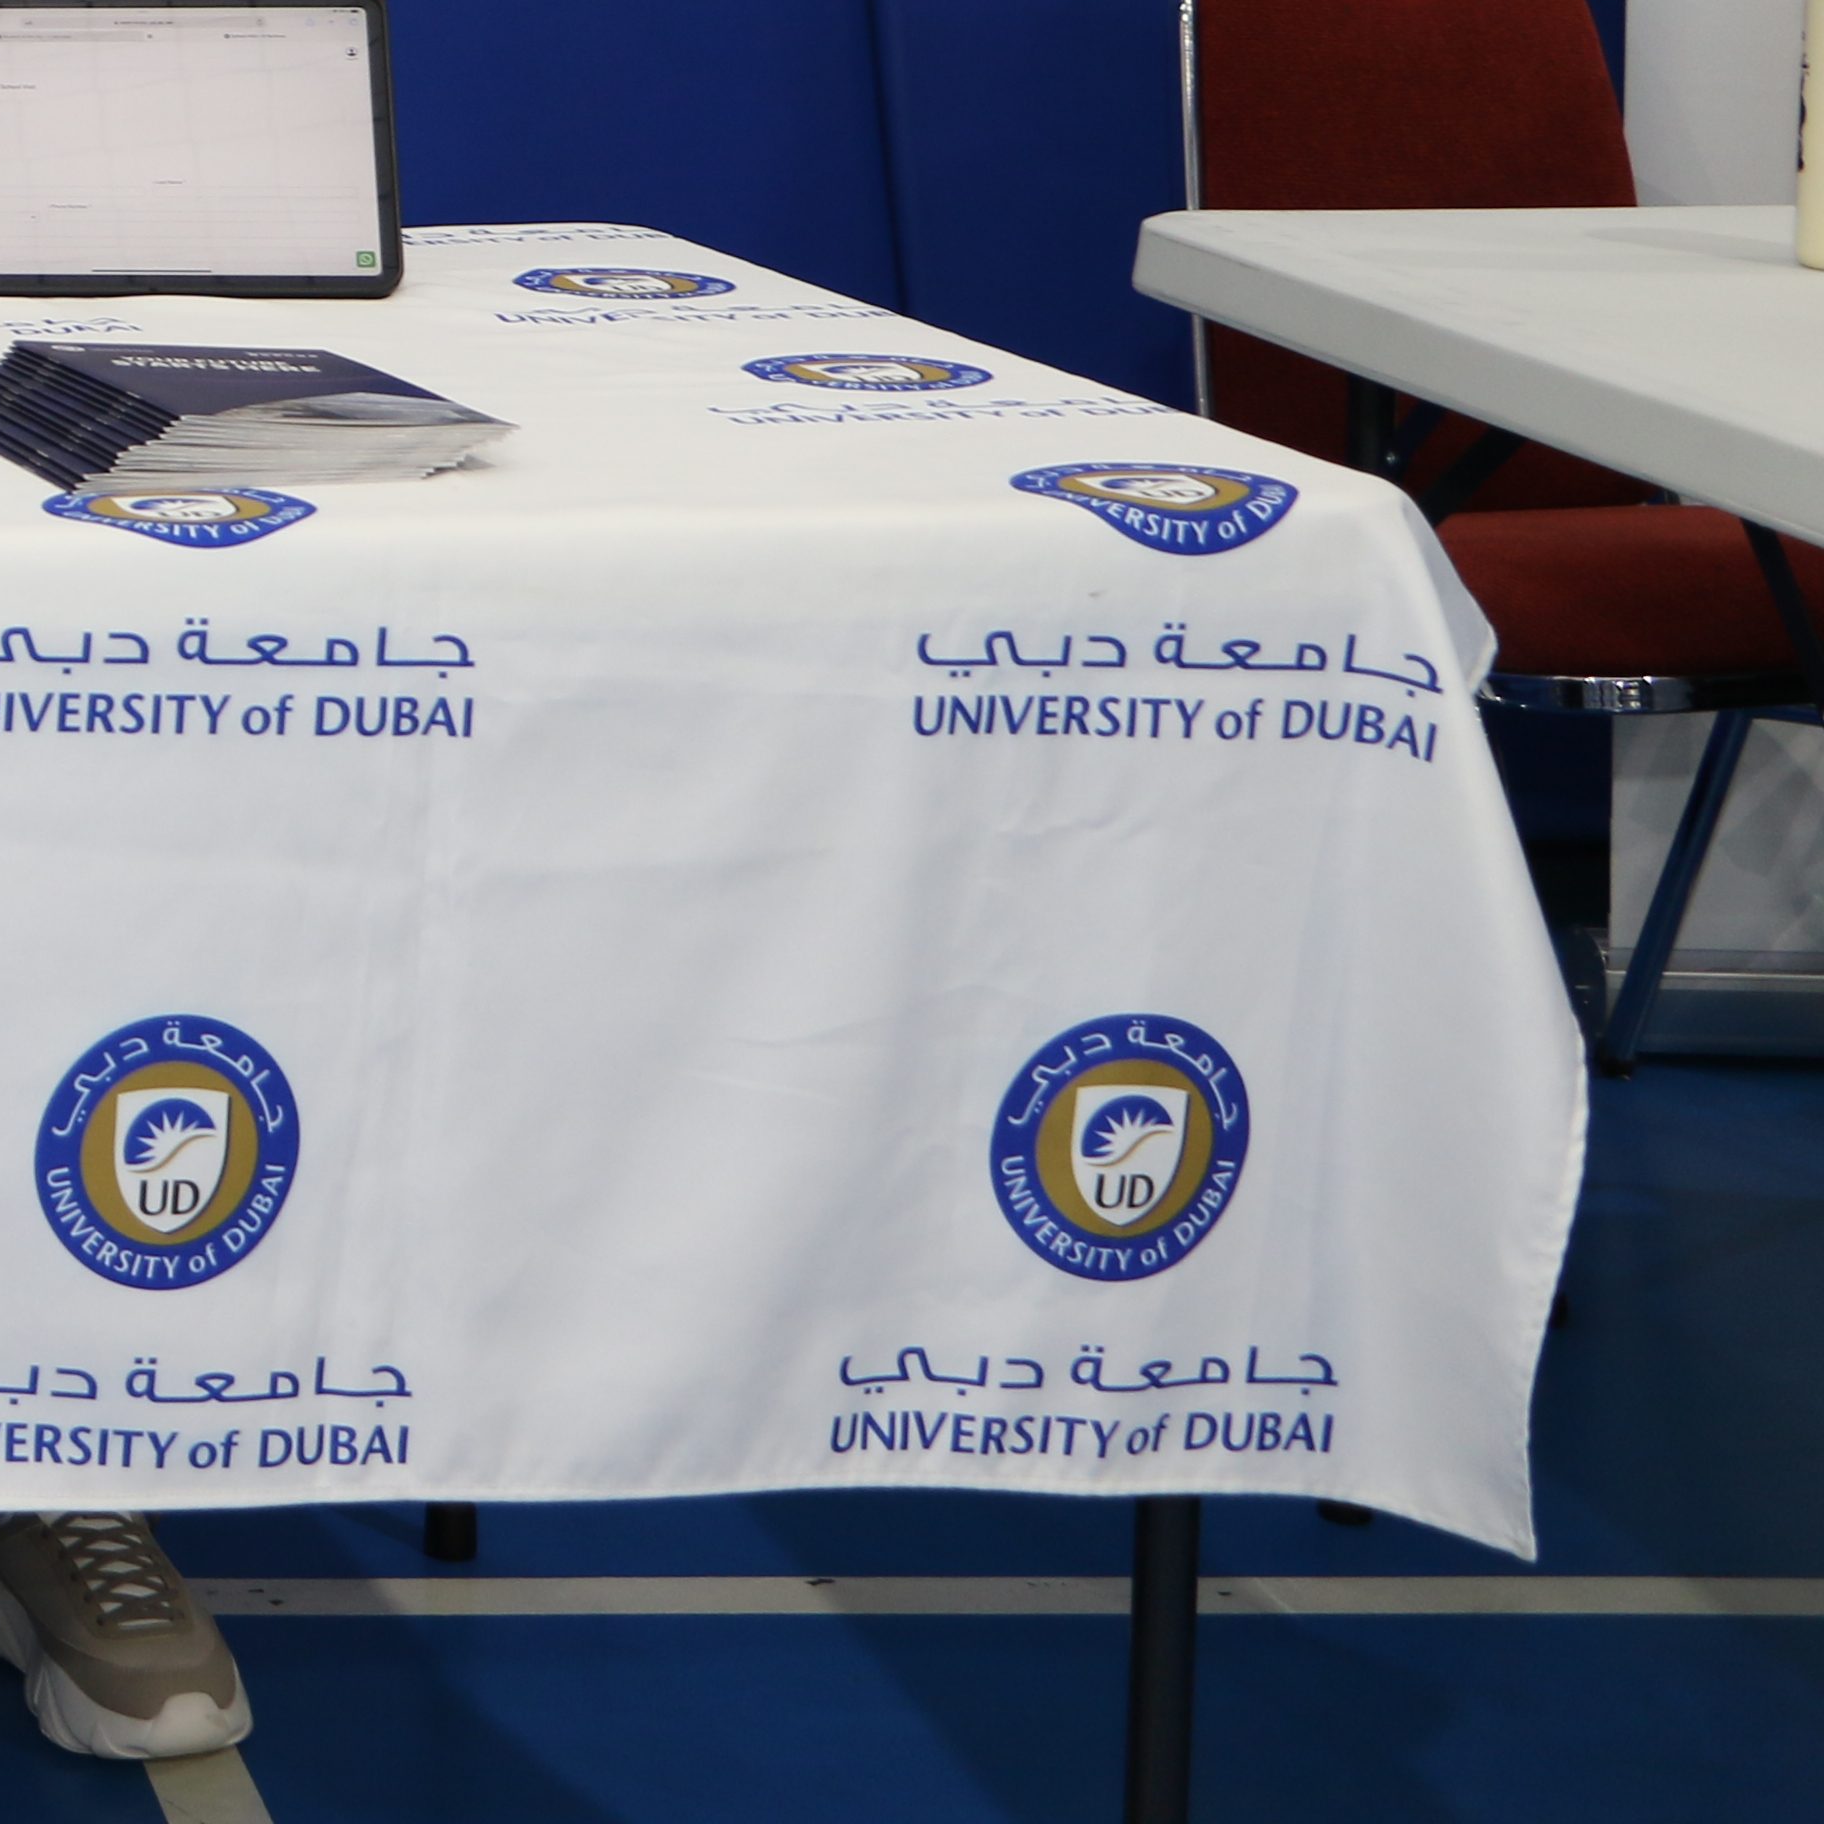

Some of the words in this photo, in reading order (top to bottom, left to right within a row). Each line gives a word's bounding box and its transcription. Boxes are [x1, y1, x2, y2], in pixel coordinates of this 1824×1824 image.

[230, 520, 260, 535] of
[1218, 510, 1247, 539] of
[177, 617, 475, 678] جامعة
[917, 631, 1127, 678] دبي
[1154, 622, 1443, 698] جامعة
[241, 695, 294, 736] of
[314, 697, 474, 738] DUBAI
[913, 695, 1204, 740] UNIVERSITY
[1215, 699, 1263, 741] of
[1281, 699, 1437, 763] DUBAI
[53, 1037, 148, 1137] دبي
[163, 1021, 282, 1132] جامعة
[1009, 1033, 1112, 1126] دبي
[1127, 1021, 1237, 1131] جامعة
[138, 1179, 200, 1216] UD
[1001, 1156, 1132, 1272] UNIVERSITY
[1141, 1237, 1169, 1265] of
[1173, 1160, 1235, 1247] DUBAI
[1095, 1174, 1156, 1209] UD
[47, 1167, 180, 1279] UNIVERSITY
[189, 1247, 218, 1273] of
[222, 1163, 285, 1252] DUBAI
[125, 1356, 412, 1408] جامعة
[840, 1346, 1044, 1397] دبي
[1070, 1345, 1339, 1396] جامعة
[189, 1429, 241, 1468] of
[258, 1425, 410, 1469] DUBAI
[830, 1411, 1119, 1458] UNIVERSITY
[1127, 1414, 1170, 1456] of
[1184, 1413, 1335, 1453] DUBAI
